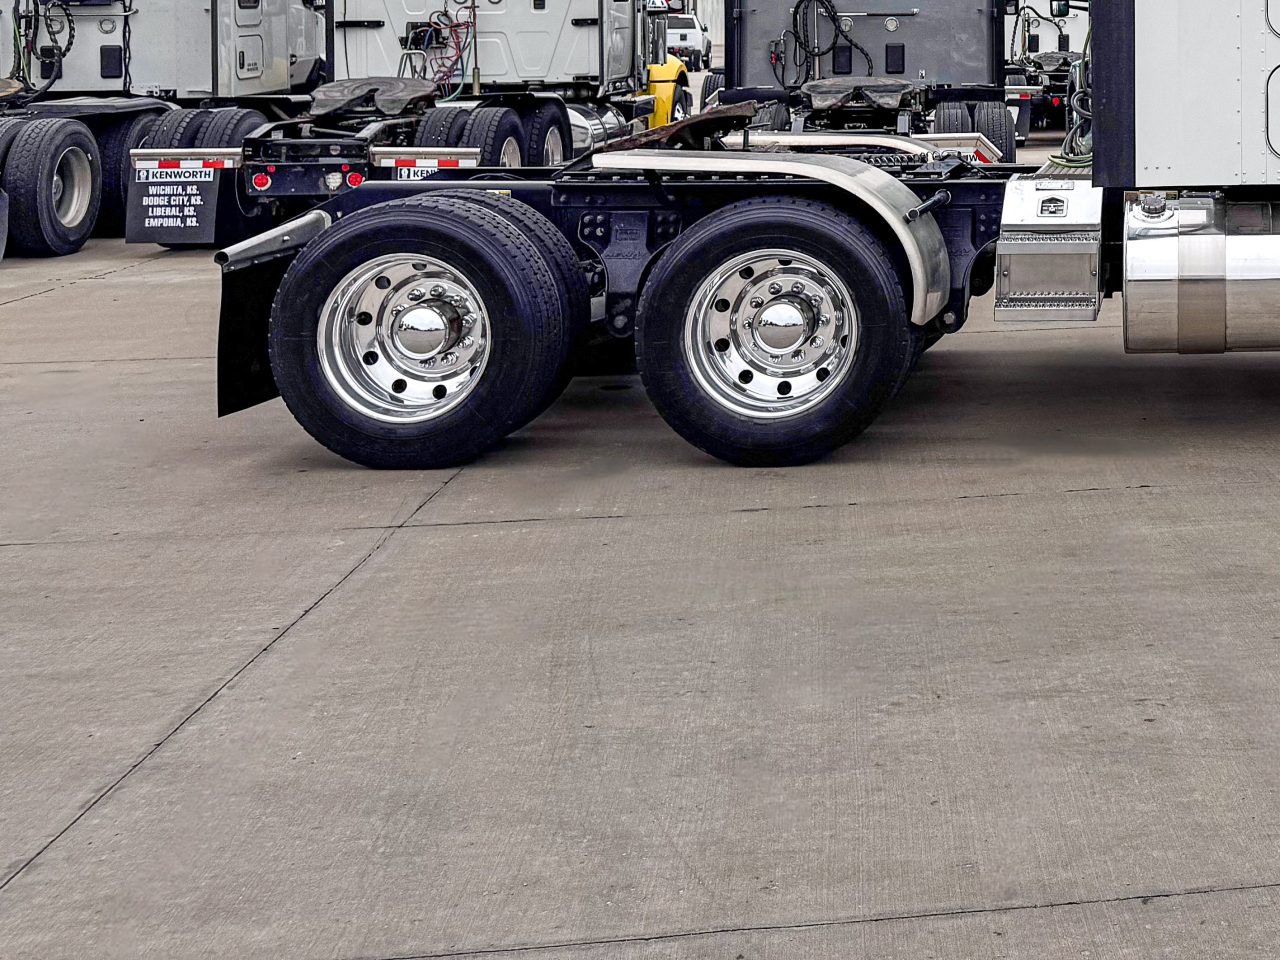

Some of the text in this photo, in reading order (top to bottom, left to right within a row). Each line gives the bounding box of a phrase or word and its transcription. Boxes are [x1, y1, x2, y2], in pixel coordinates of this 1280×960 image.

[151, 170, 211, 179] KENWORTH
[412, 169, 438, 178] KEN
[148, 185, 200, 195] WICHITA, KS.
[142, 195, 204, 206] DODGE CITY, KS.
[148, 206, 197, 216] LIBERAL, KS.
[144, 217, 200, 228] EMPORIA, KS.
